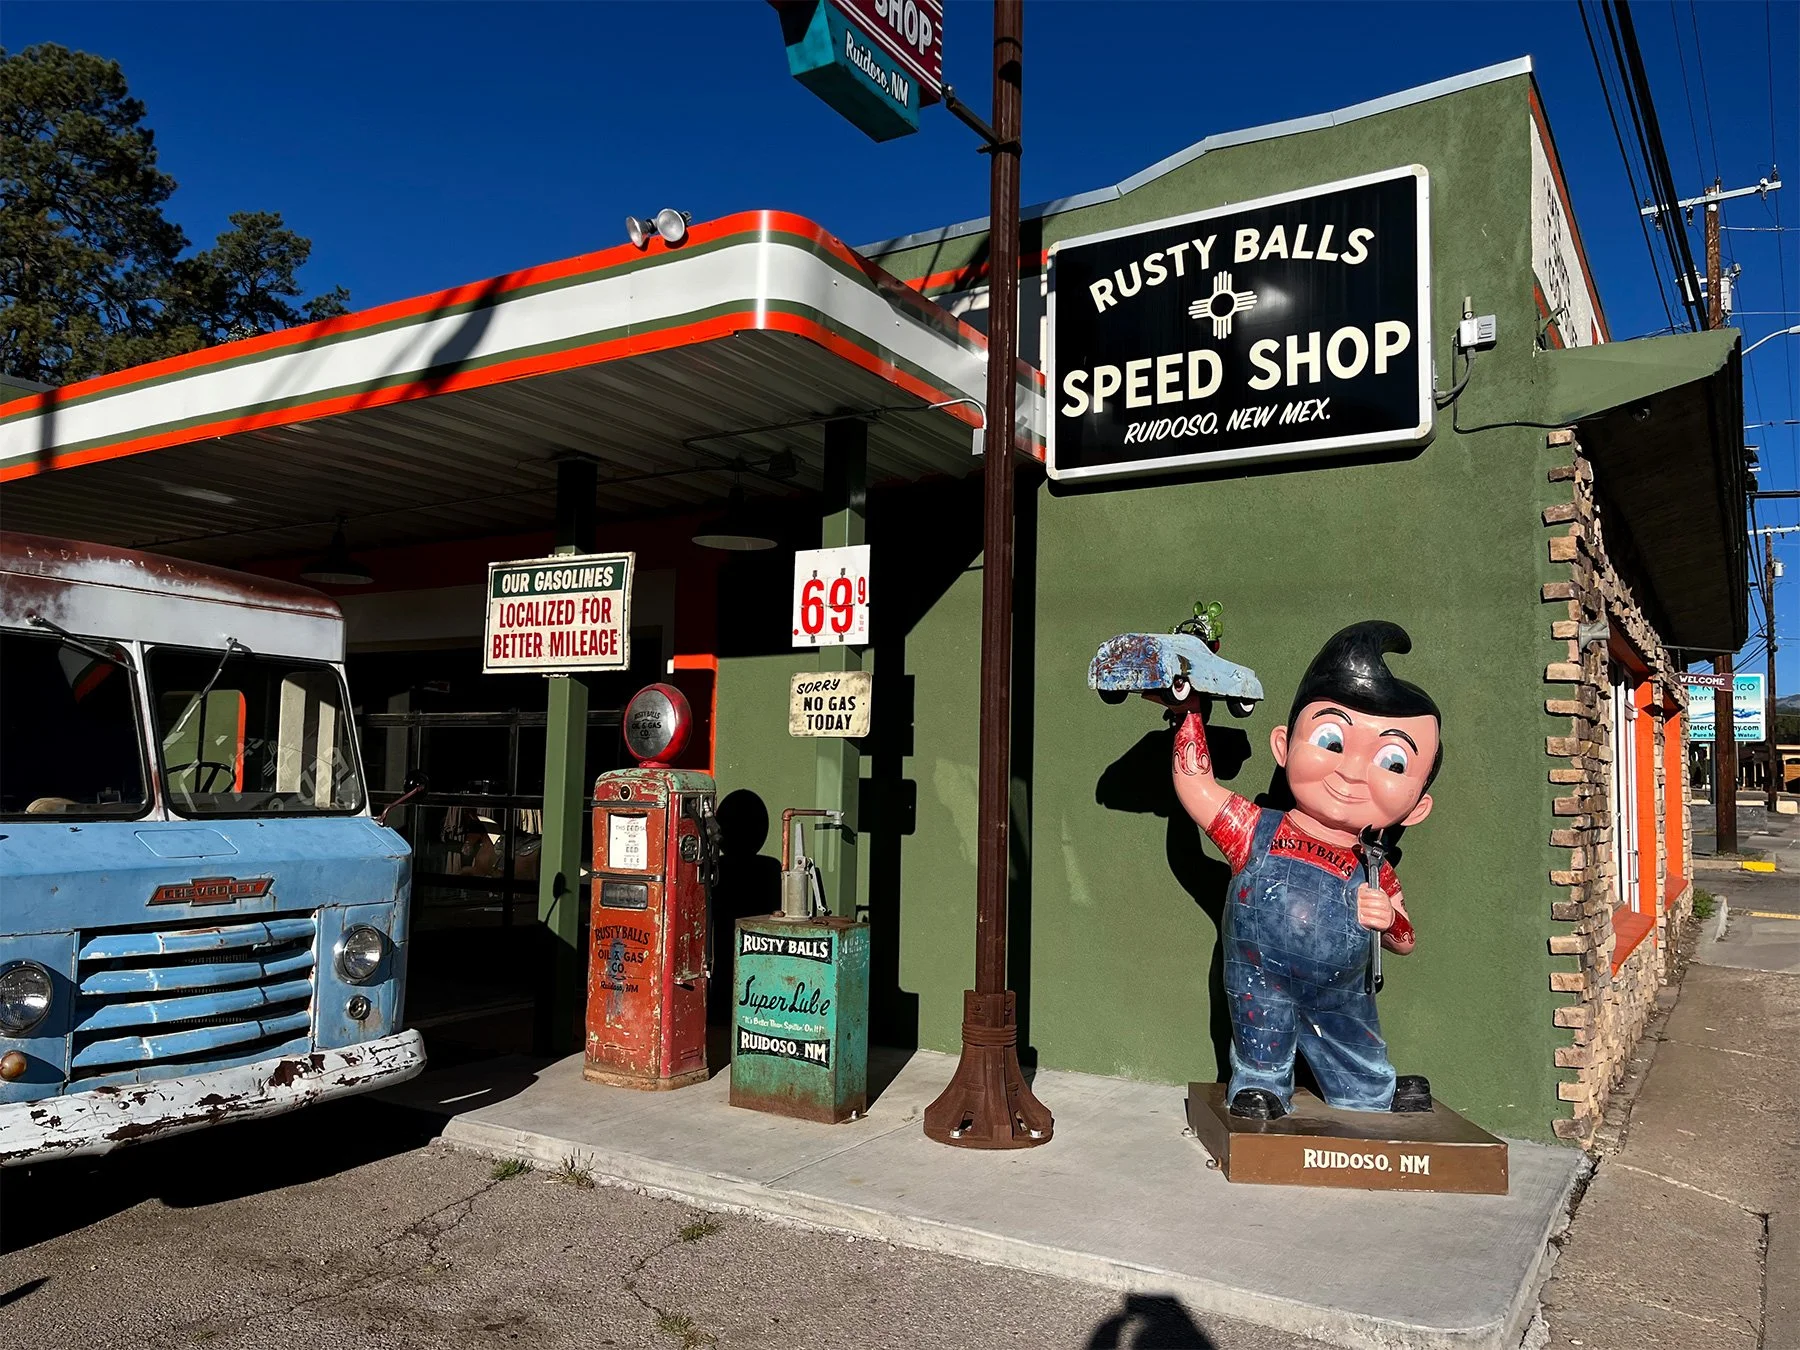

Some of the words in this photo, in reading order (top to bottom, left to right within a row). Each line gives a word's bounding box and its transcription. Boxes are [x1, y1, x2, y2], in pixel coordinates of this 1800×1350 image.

[846, 30, 889, 93] Ruidoso,
[891, 71, 908, 107] NM
[1089, 234, 1217, 313] RUSTY
[1234, 224, 1375, 265] BALLS
[1061, 349, 1223, 418] SPEED
[1247, 320, 1411, 391] SHOP
[1124, 412, 1219, 444] RUIDOSO,
[1226, 404, 1277, 431] NEW
[1279, 397, 1331, 424] MEX.
[502, 573, 530, 594] OUR
[534, 566, 614, 592] GASOLINES
[499, 600, 575, 628] LOCALIZED
[582, 597, 611, 624] FOR
[493, 632, 542, 659] BETTER
[550, 629, 618, 657] MILEAGE
[796, 678, 841, 694] SORRY
[1679, 675, 1725, 686] WELCOME
[803, 696, 823, 711] NO
[829, 696, 856, 711] GAS
[806, 714, 852, 731] TODAY
[1270, 838, 1316, 853] RUSTY
[1316, 847, 1354, 877] BALLS
[164, 883, 256, 899] CHEVROLET
[594, 926, 621, 941] RUSTY
[621, 926, 650, 945] BALLS
[742, 934, 787, 954] RUSTY
[788, 940, 828, 959] BALLS
[598, 949, 611, 960] OIL
[623, 952, 644, 963] GAS
[611, 962, 627, 974] CO.
[739, 975, 788, 1014] Super
[788, 981, 830, 1016] Lube
[804, 1043, 826, 1063] NM
[1400, 1154, 1430, 1176] NM
